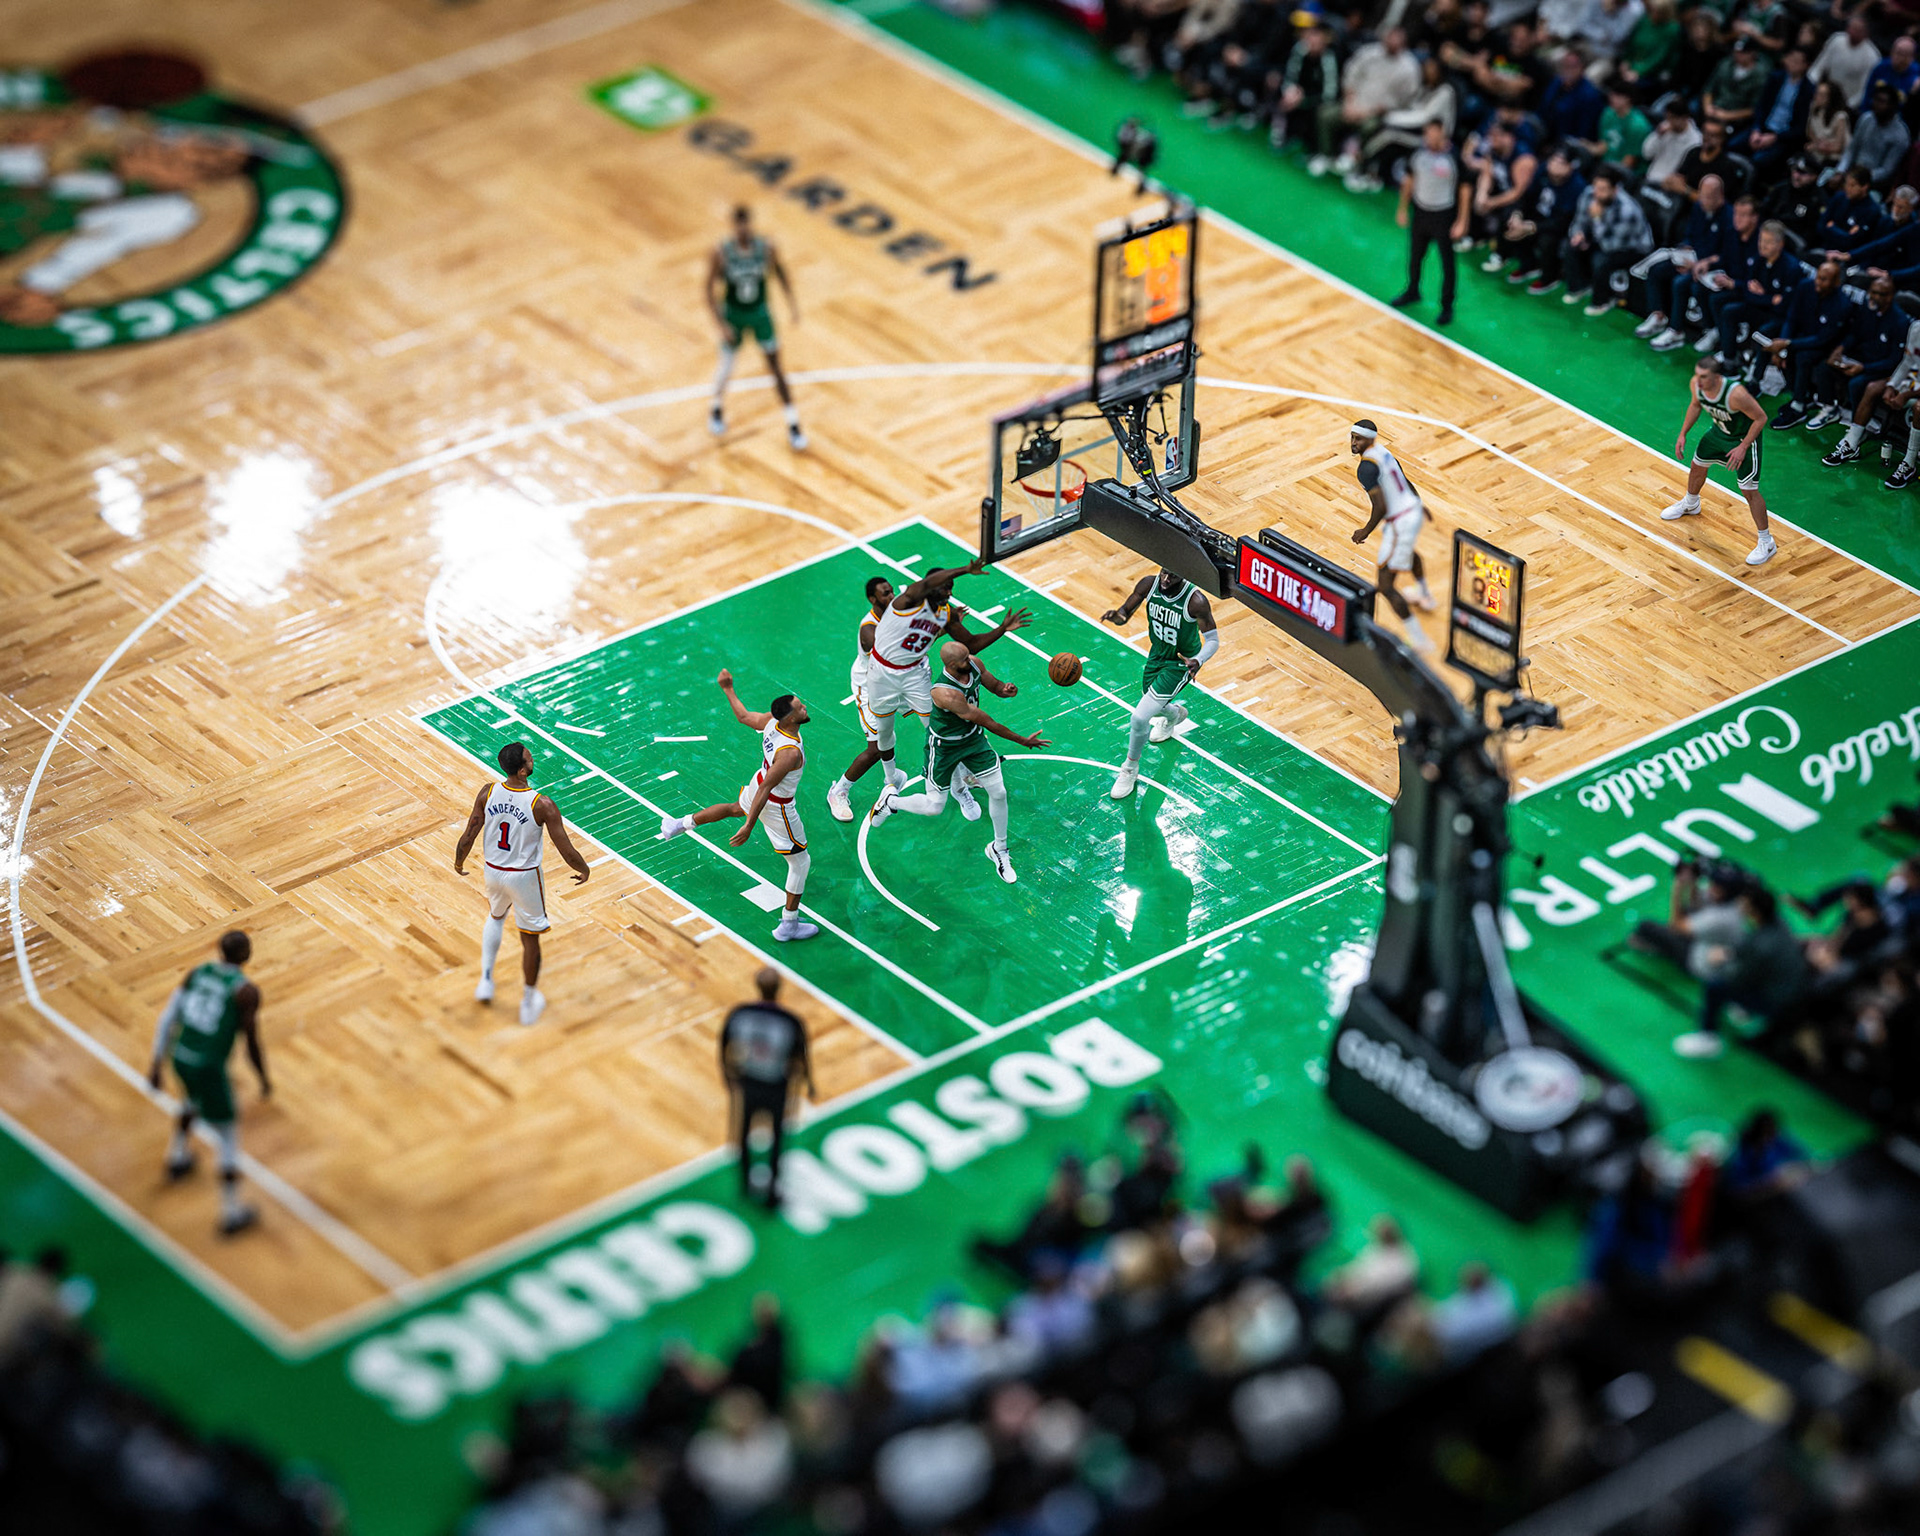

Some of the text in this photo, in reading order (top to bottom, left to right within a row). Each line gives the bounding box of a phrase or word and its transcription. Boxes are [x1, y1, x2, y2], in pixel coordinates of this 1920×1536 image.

[687, 119, 996, 292] GARDEN
[56, 187, 338, 348] CELTICS
[1149, 602, 1182, 629] BOSTON
[1251, 558, 1275, 593] GET
[1276, 571, 1301, 609] THE
[901, 632, 932, 653] 23
[1152, 620, 1178, 646] 88
[1577, 705, 1801, 818] Courtside
[1800, 705, 1920, 804] helob
[487, 803, 529, 825] ANDERSON
[497, 821, 511, 852] 1
[777, 1016, 1164, 1237] BOSTON
[349, 1202, 757, 1420] CELTICS
